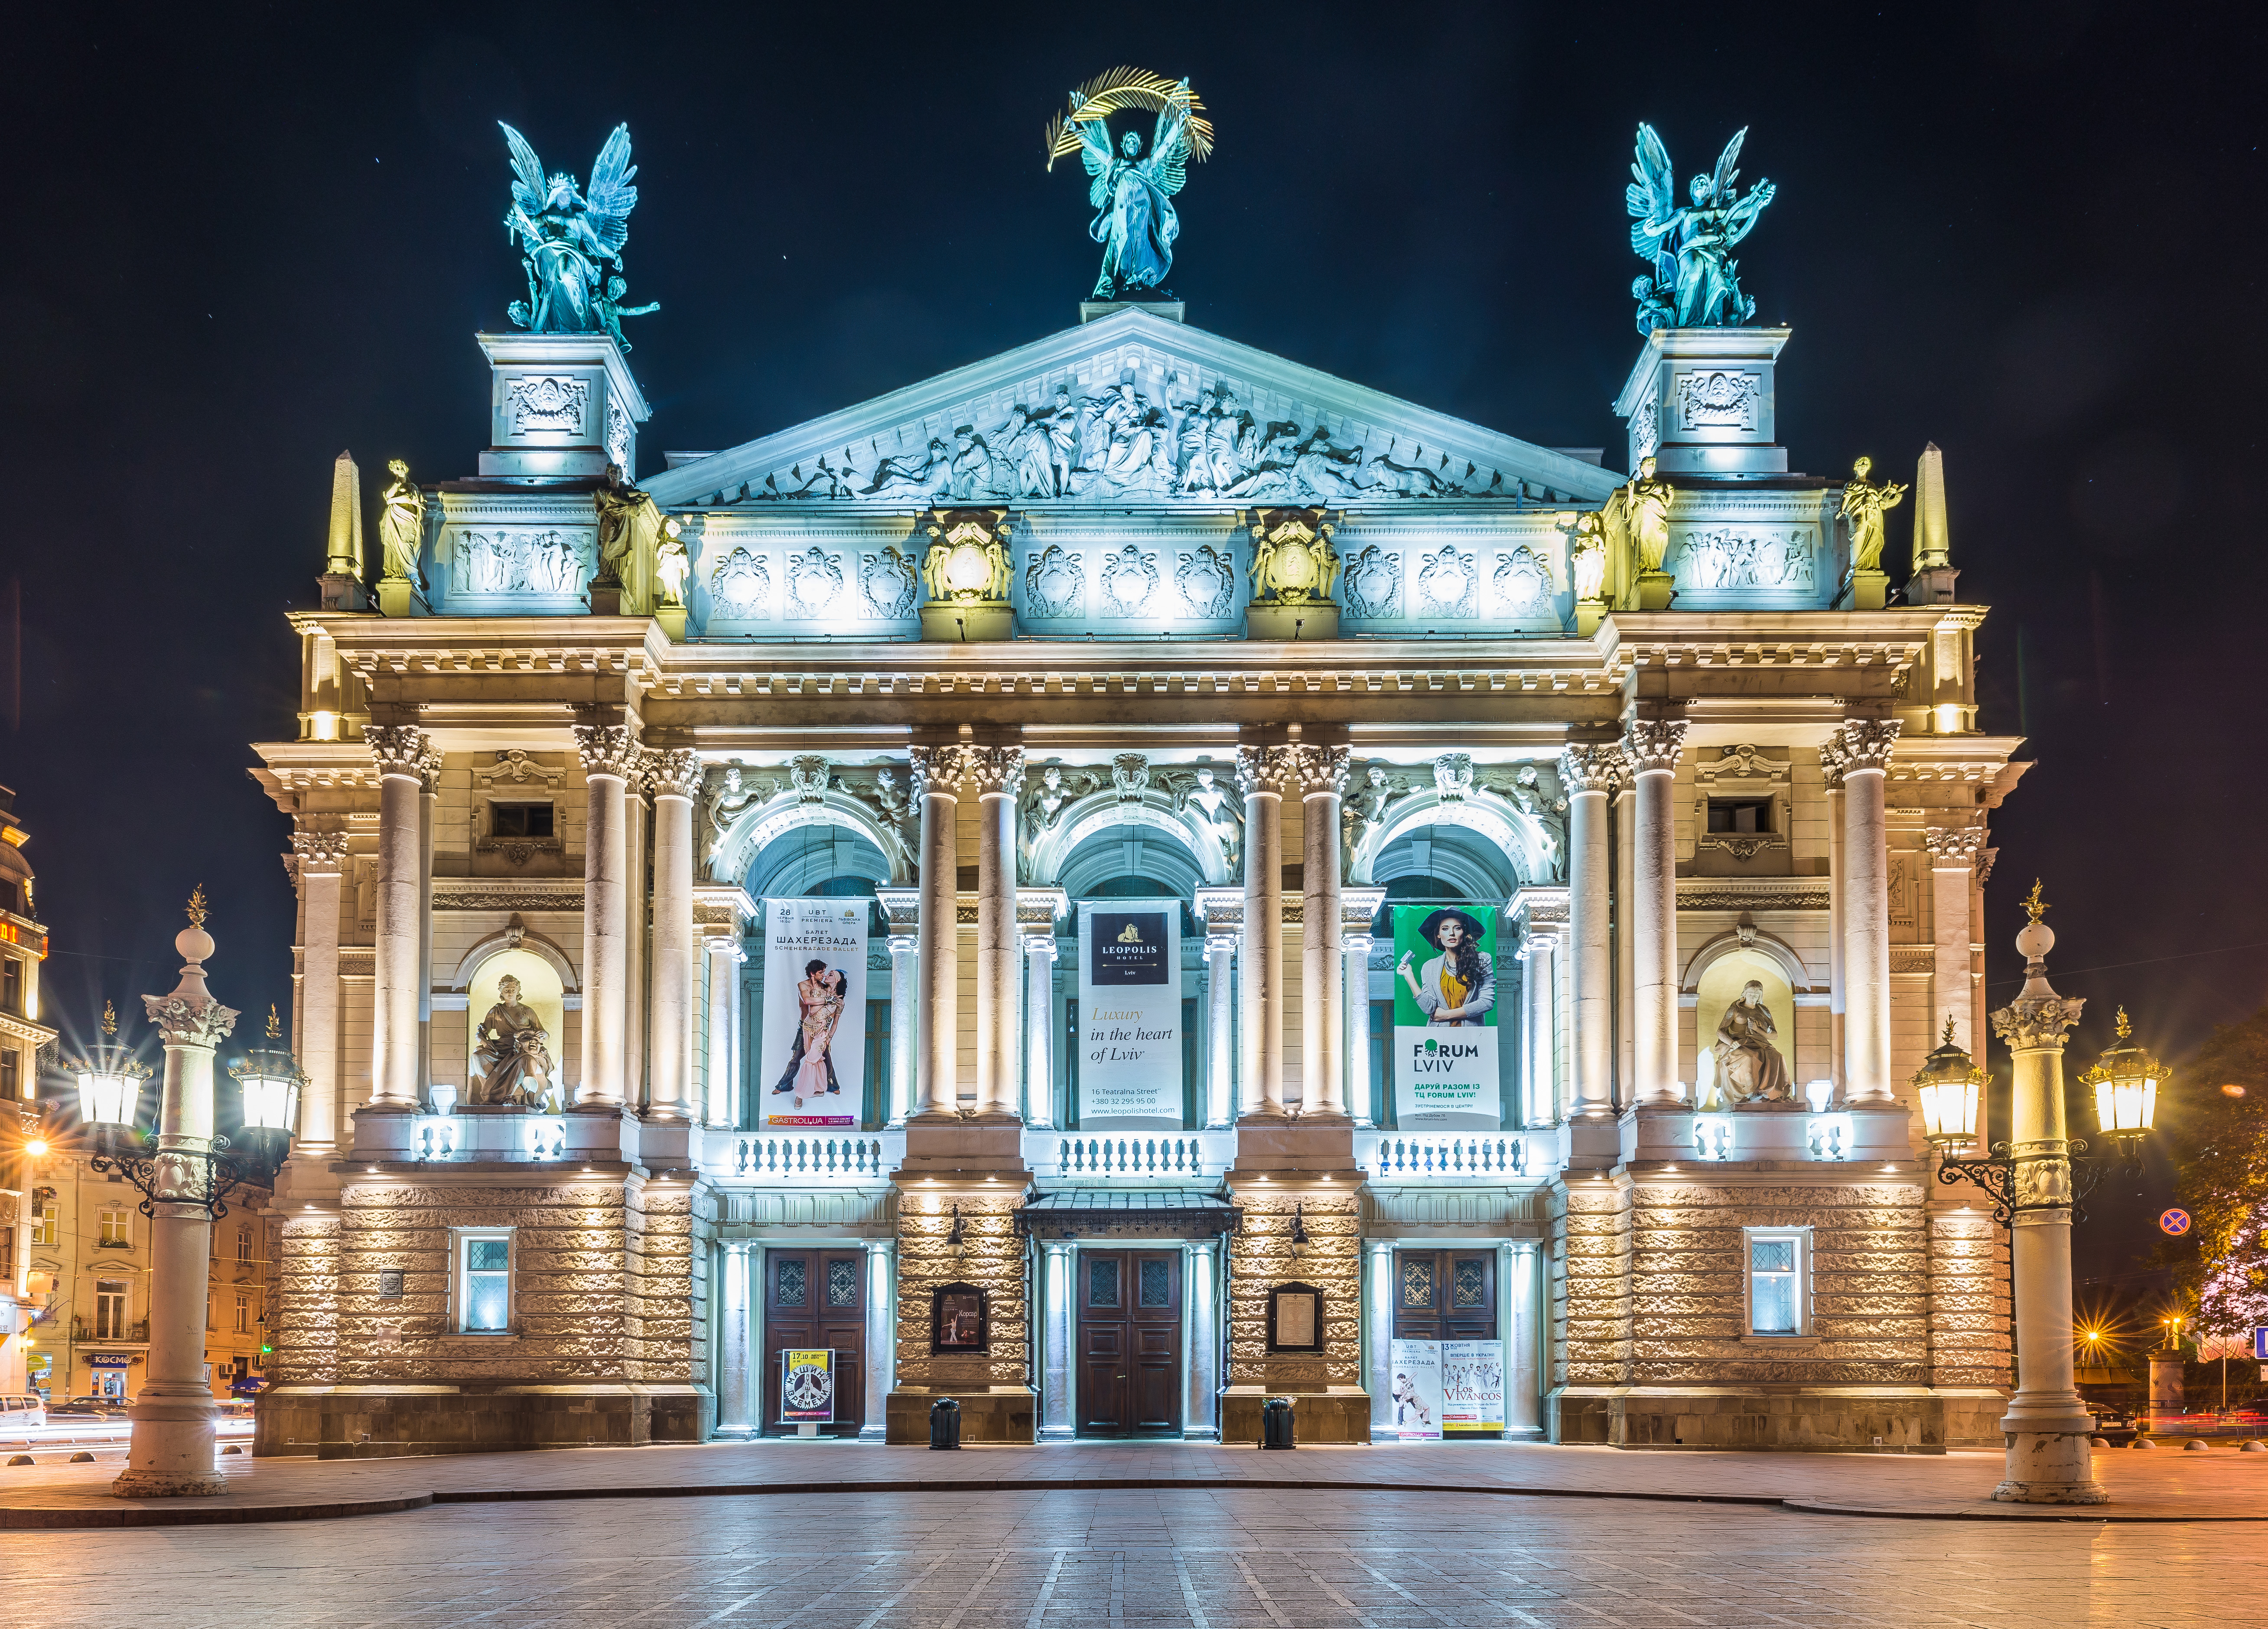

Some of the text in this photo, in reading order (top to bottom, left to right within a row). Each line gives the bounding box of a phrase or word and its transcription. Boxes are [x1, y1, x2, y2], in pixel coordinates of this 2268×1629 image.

[777, 936, 857, 945] ШАХЕРЕЗАДА
[1091, 1007, 1143, 1023] Luxury
[1091, 1027, 1173, 1041] in the heart
[1414, 1039, 1478, 1057] FORUM
[1091, 1047, 1108, 1064] of
[1414, 1060, 1454, 1072] LVIV
[1091, 1107, 1175, 1115] www.leopolishotel.com
[959, 1310, 977, 1318] Корсар
[95, 1355, 131, 1364] КОСМО
[787, 1366, 829, 1385] МАШИНА
[788, 1389, 829, 1407] ВРЕМЕНИ
[1443, 1388, 1501, 1401] VIVANCOS
